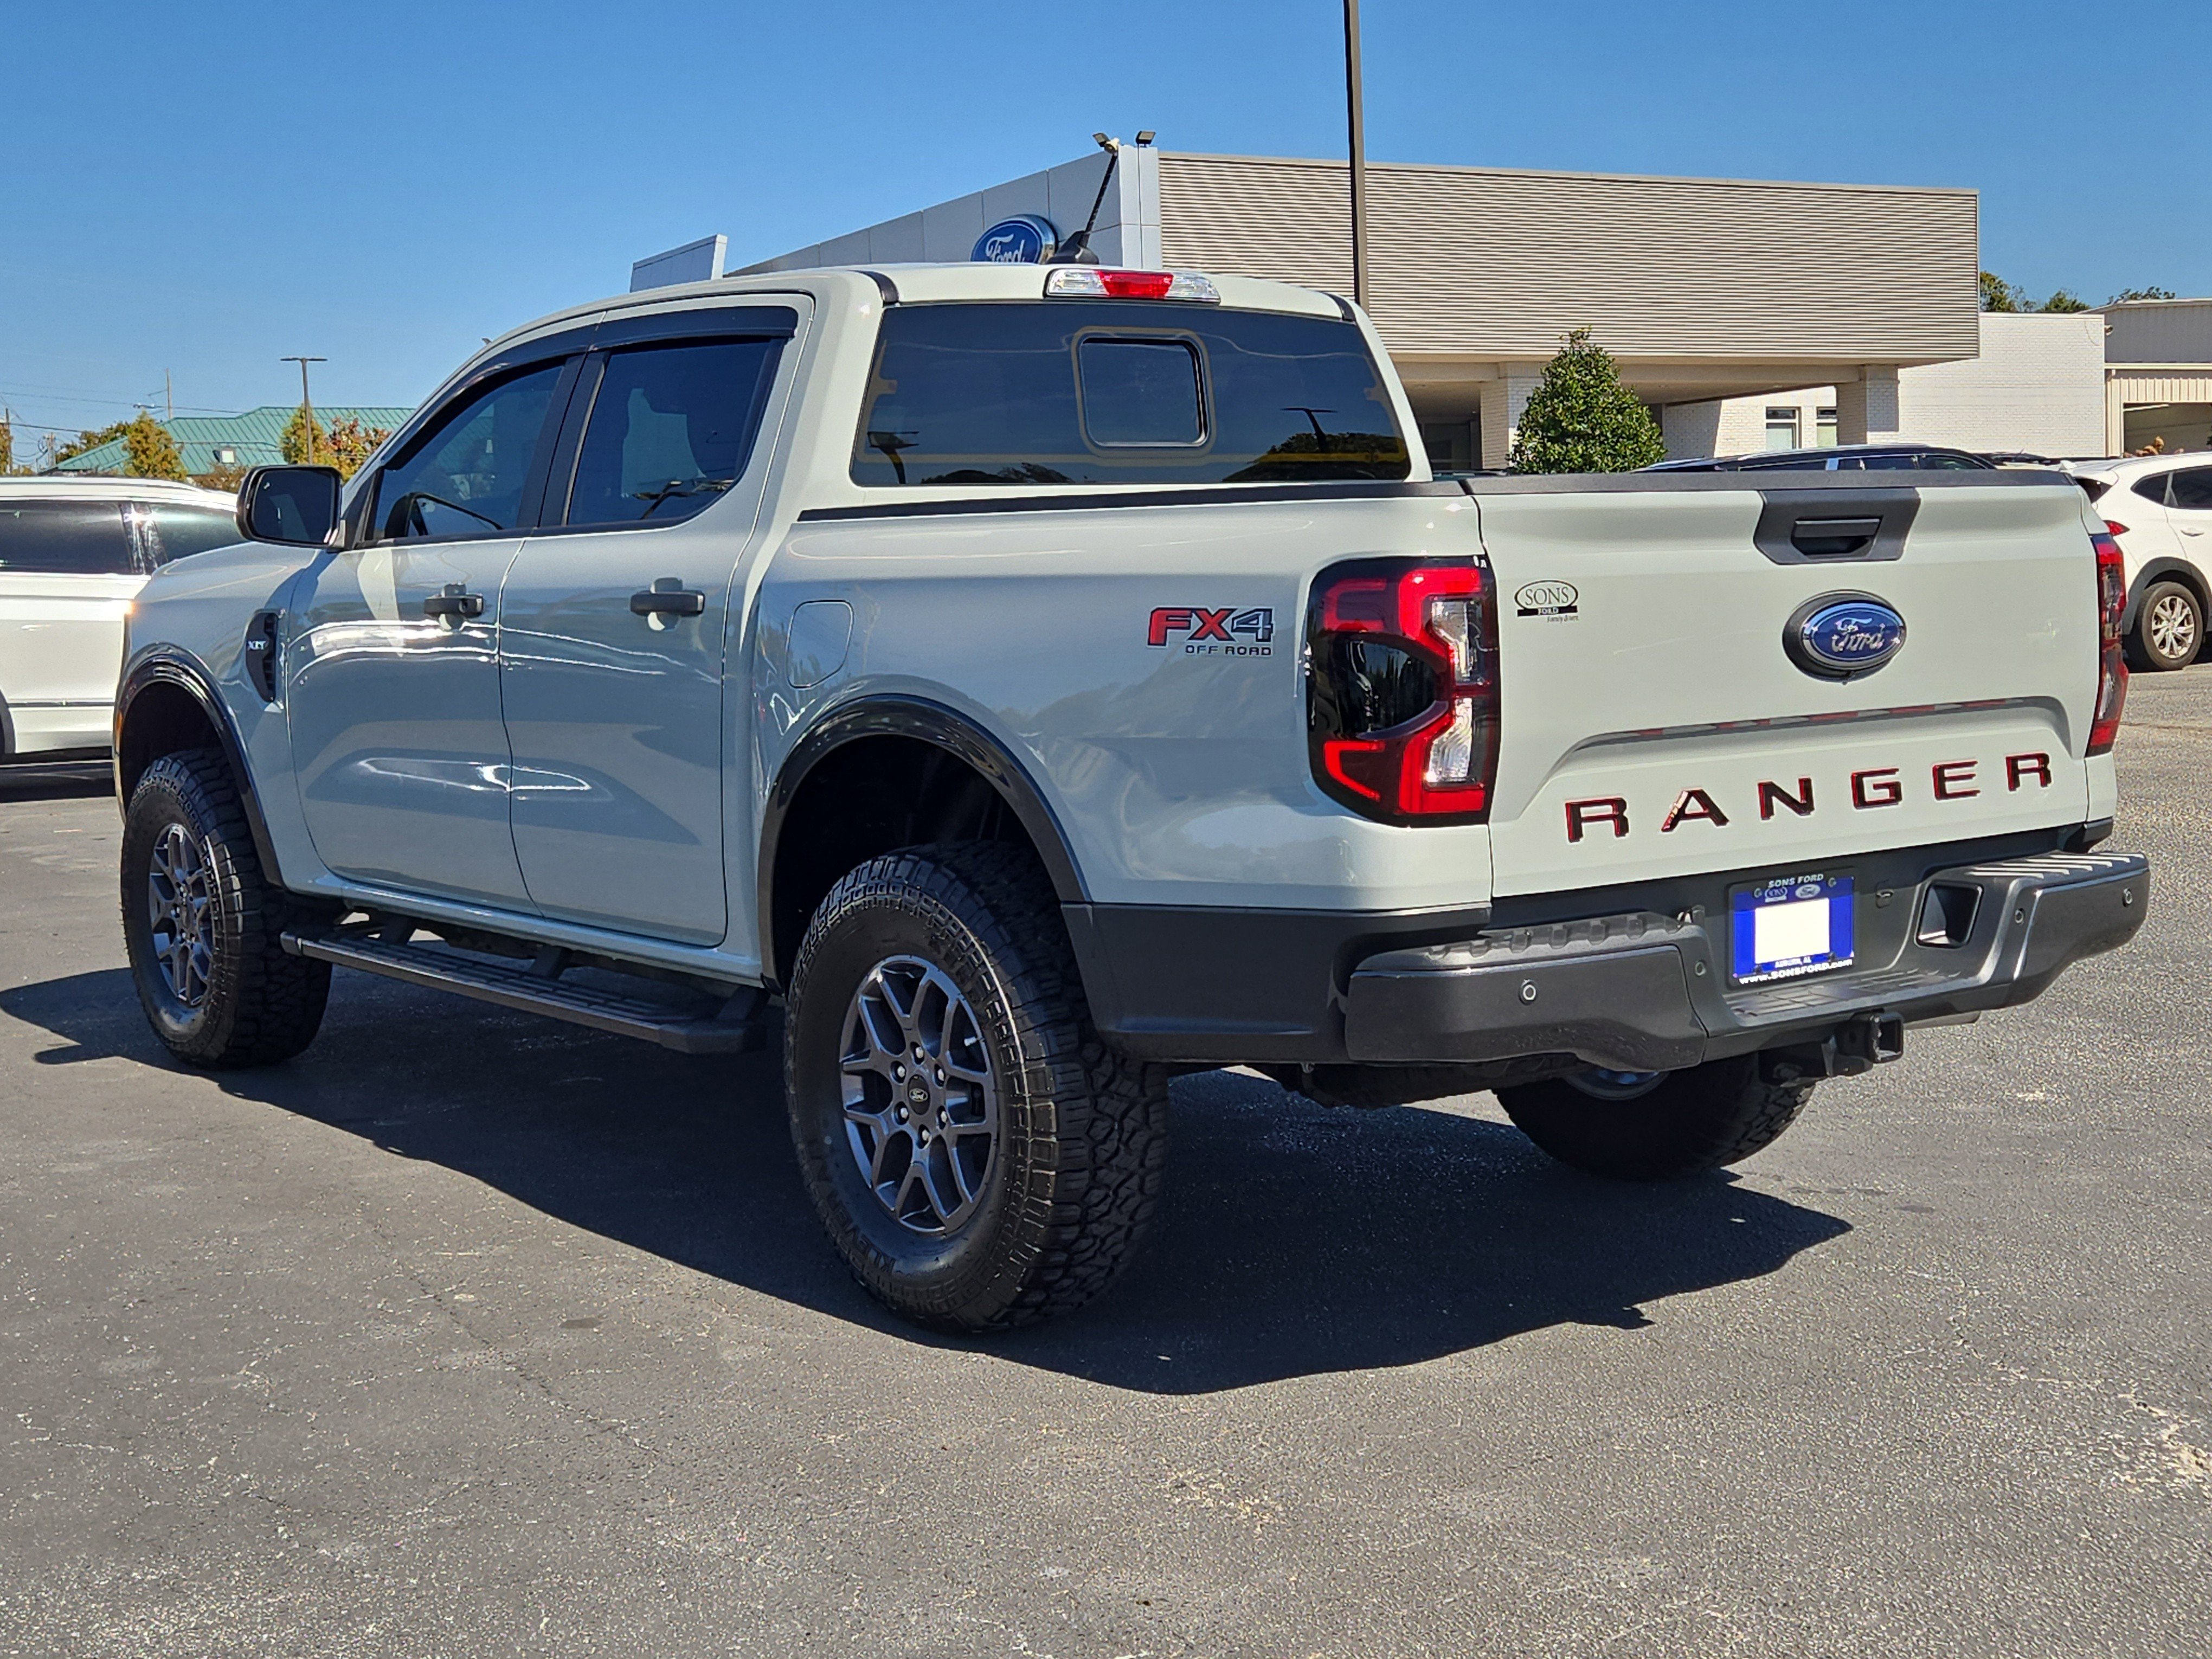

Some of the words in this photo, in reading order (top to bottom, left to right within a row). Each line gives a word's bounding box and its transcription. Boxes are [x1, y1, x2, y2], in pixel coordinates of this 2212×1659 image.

[986, 233, 1025, 262] Ford
[1525, 586, 1569, 606] SONS
[1147, 607, 1274, 646] FX4
[1831, 617, 1885, 653] Ford
[1185, 645, 1208, 654] OFF
[1225, 646, 1272, 656] ROAD
[1564, 753, 2053, 843] RANGER
[1768, 878, 1796, 888] SONS
[1797, 873, 1824, 884] FORD
[826, 1188, 896, 1274] KLEVER
